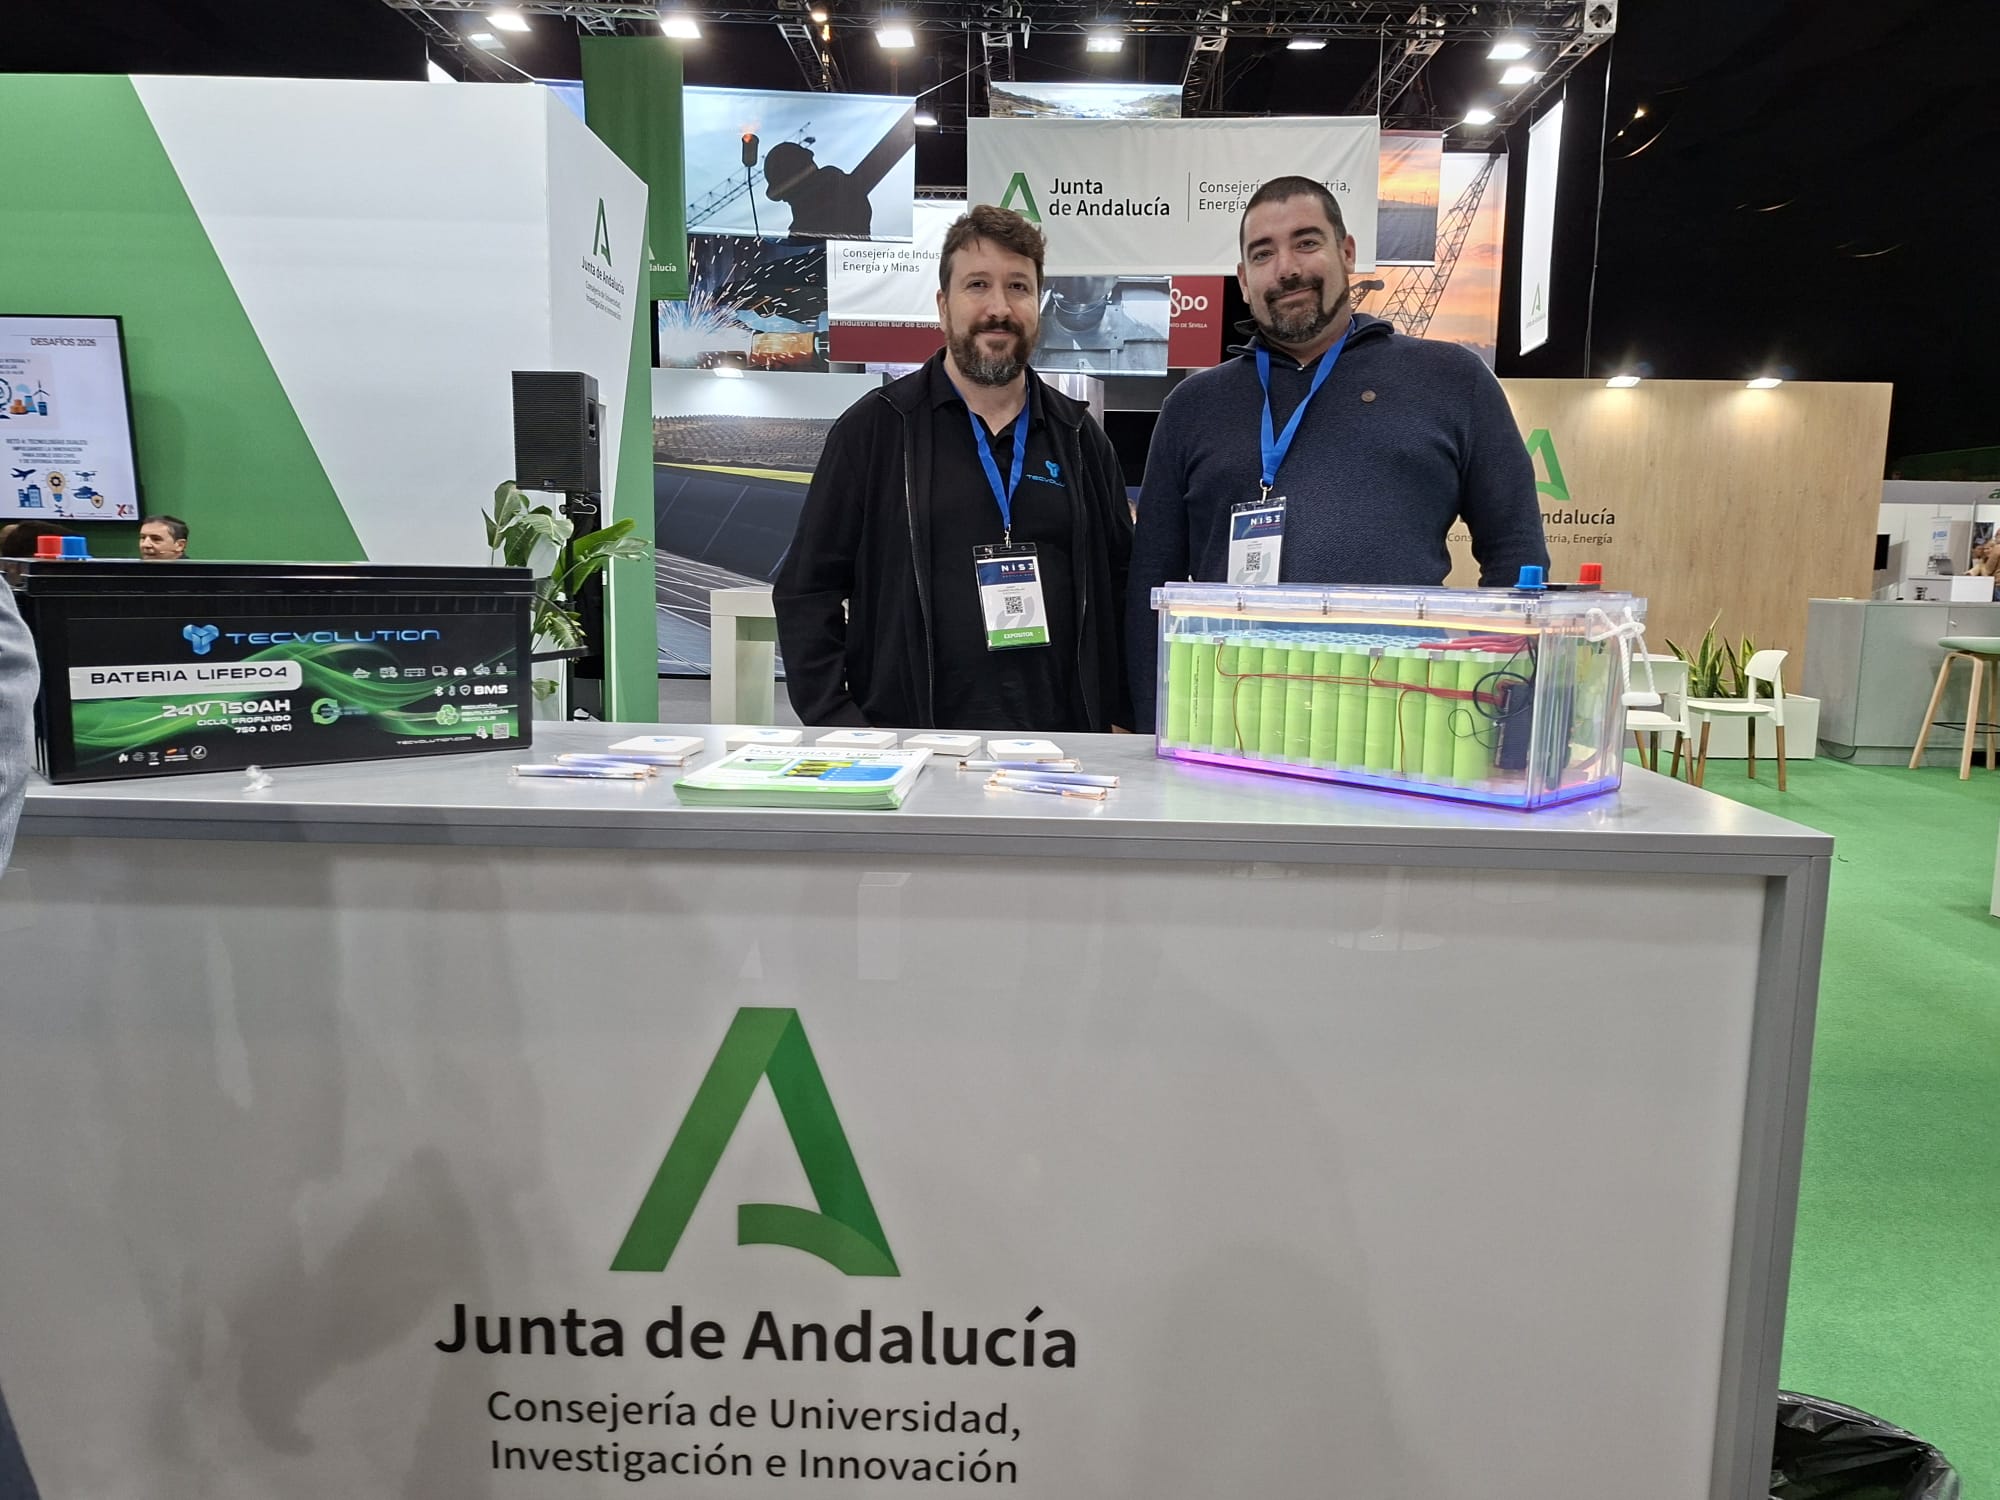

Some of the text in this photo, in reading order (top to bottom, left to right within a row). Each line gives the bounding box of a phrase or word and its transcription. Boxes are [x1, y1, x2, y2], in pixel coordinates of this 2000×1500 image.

[1049, 178, 1103, 195] Junta
[1049, 197, 1170, 216] de Andalucía
[1199, 197, 1247, 213] Energía
[843, 248, 940, 260] Consejería de Indus
[843, 262, 920, 274] Energía y Minas
[581, 256, 595, 276] Junta
[602, 271, 625, 296] Andalucía
[31, 336, 75, 347] DESAFÍOS
[1573, 533, 1613, 546] Energía
[225, 629, 441, 645] TECVOLUTION
[1003, 631, 1034, 640] EXPOSITOR
[90, 670, 188, 685] BATERIA
[473, 684, 509, 695] BMS
[162, 699, 291, 718] 24V 150AH
[196, 714, 292, 726] CICLO PROFUNDO
[270, 723, 293, 733] (DC)
[434, 1302, 1079, 1370] Junta de Andalucía
[487, 1390, 1022, 1443] Consejería de Universidad,
[490, 1439, 1019, 1485] Investigación e Innovación
